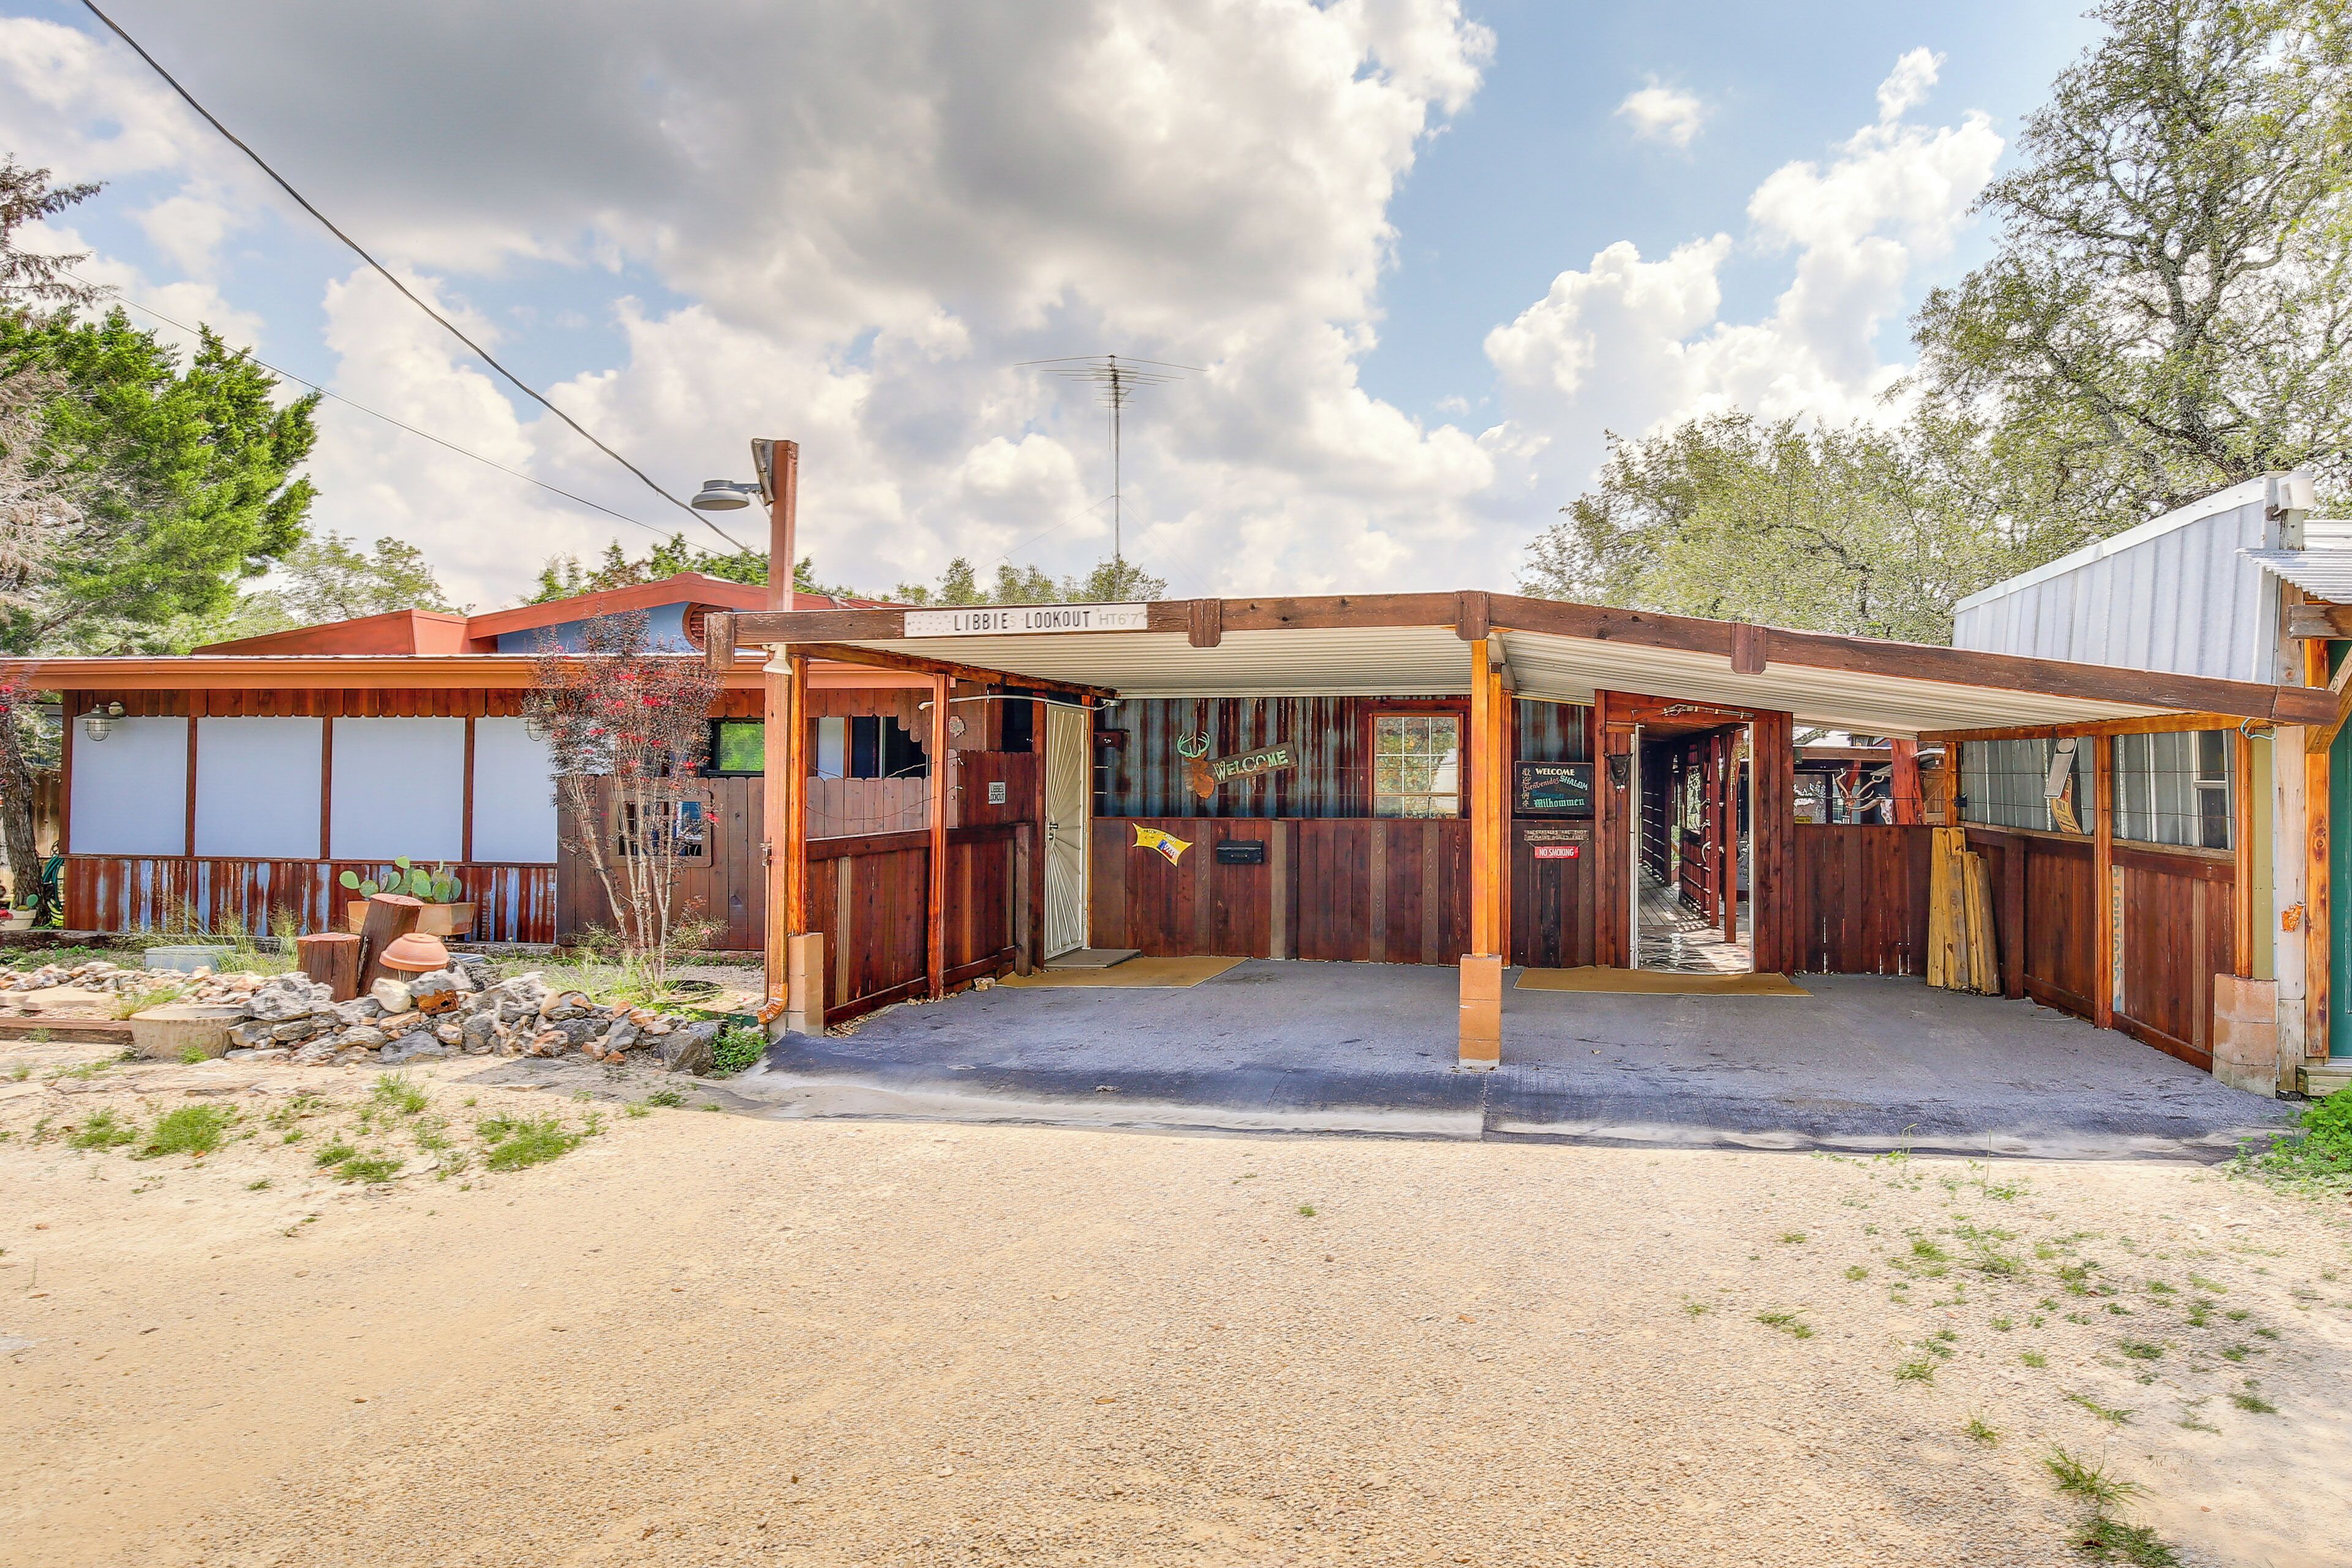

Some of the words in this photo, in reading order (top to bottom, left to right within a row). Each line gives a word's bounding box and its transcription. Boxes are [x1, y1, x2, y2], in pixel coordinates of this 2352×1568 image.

[1025, 611, 1090, 628] LOOKOUT
[1213, 749, 1288, 781] WELCOME
[1535, 767, 1575, 776] WELCOME
[1559, 775, 1588, 791] SHALOM
